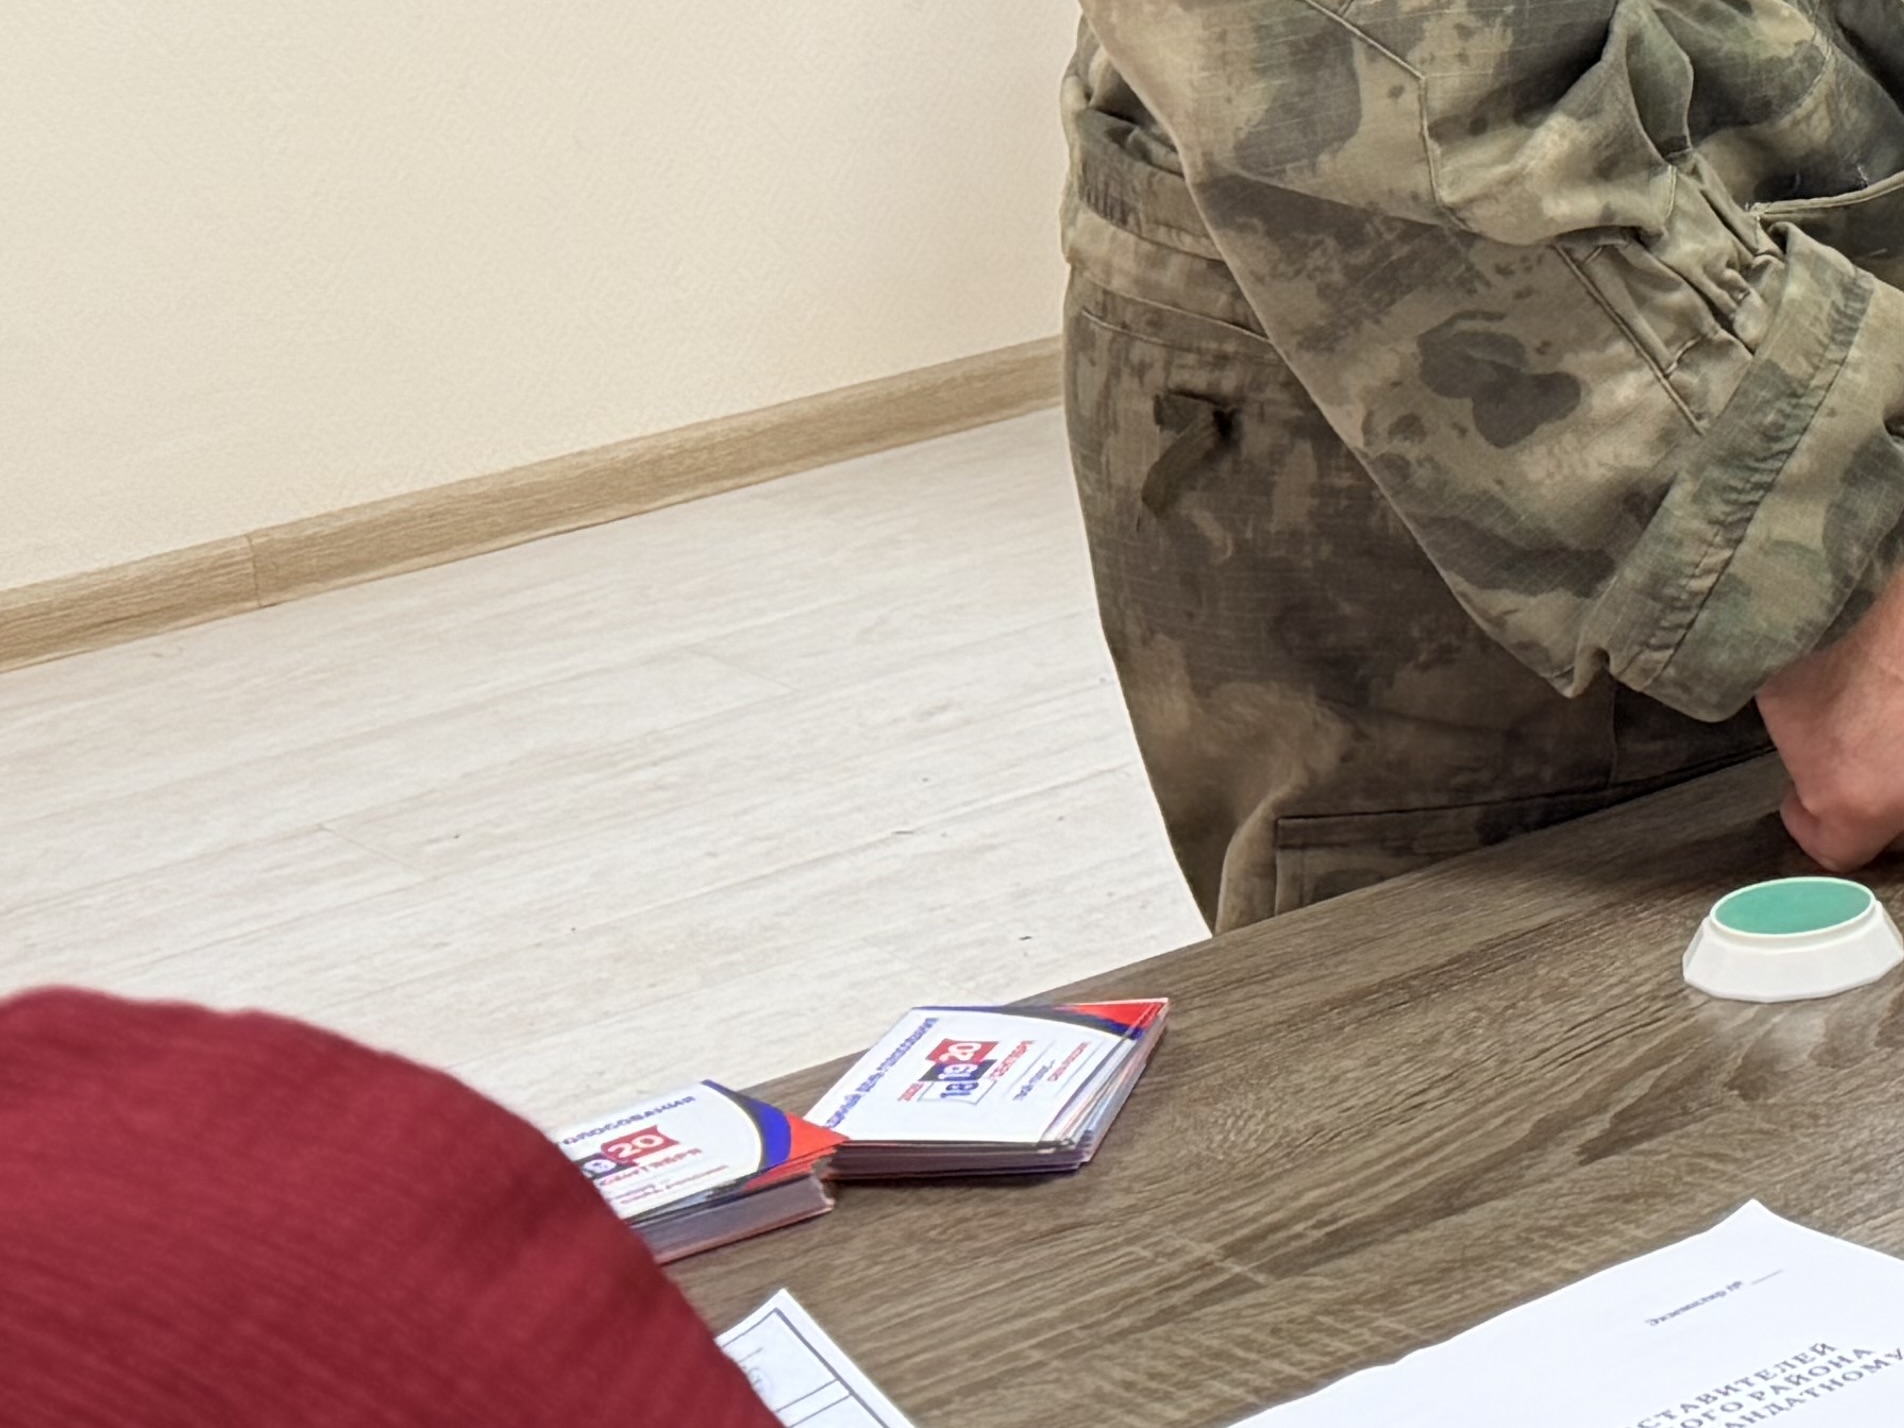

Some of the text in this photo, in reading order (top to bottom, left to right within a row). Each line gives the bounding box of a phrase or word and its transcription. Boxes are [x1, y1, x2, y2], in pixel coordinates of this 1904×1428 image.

[563, 1095, 697, 1145] ОЛОСОВАНИЯ
[607, 1133, 665, 1159] 20
[1634, 1342, 1838, 1428] СТАВИТЕЛЕЙ
[1678, 1347, 1876, 1428] ОГО РАЙОНА
[1723, 1347, 1904, 1428] АНДАТНОМУ
